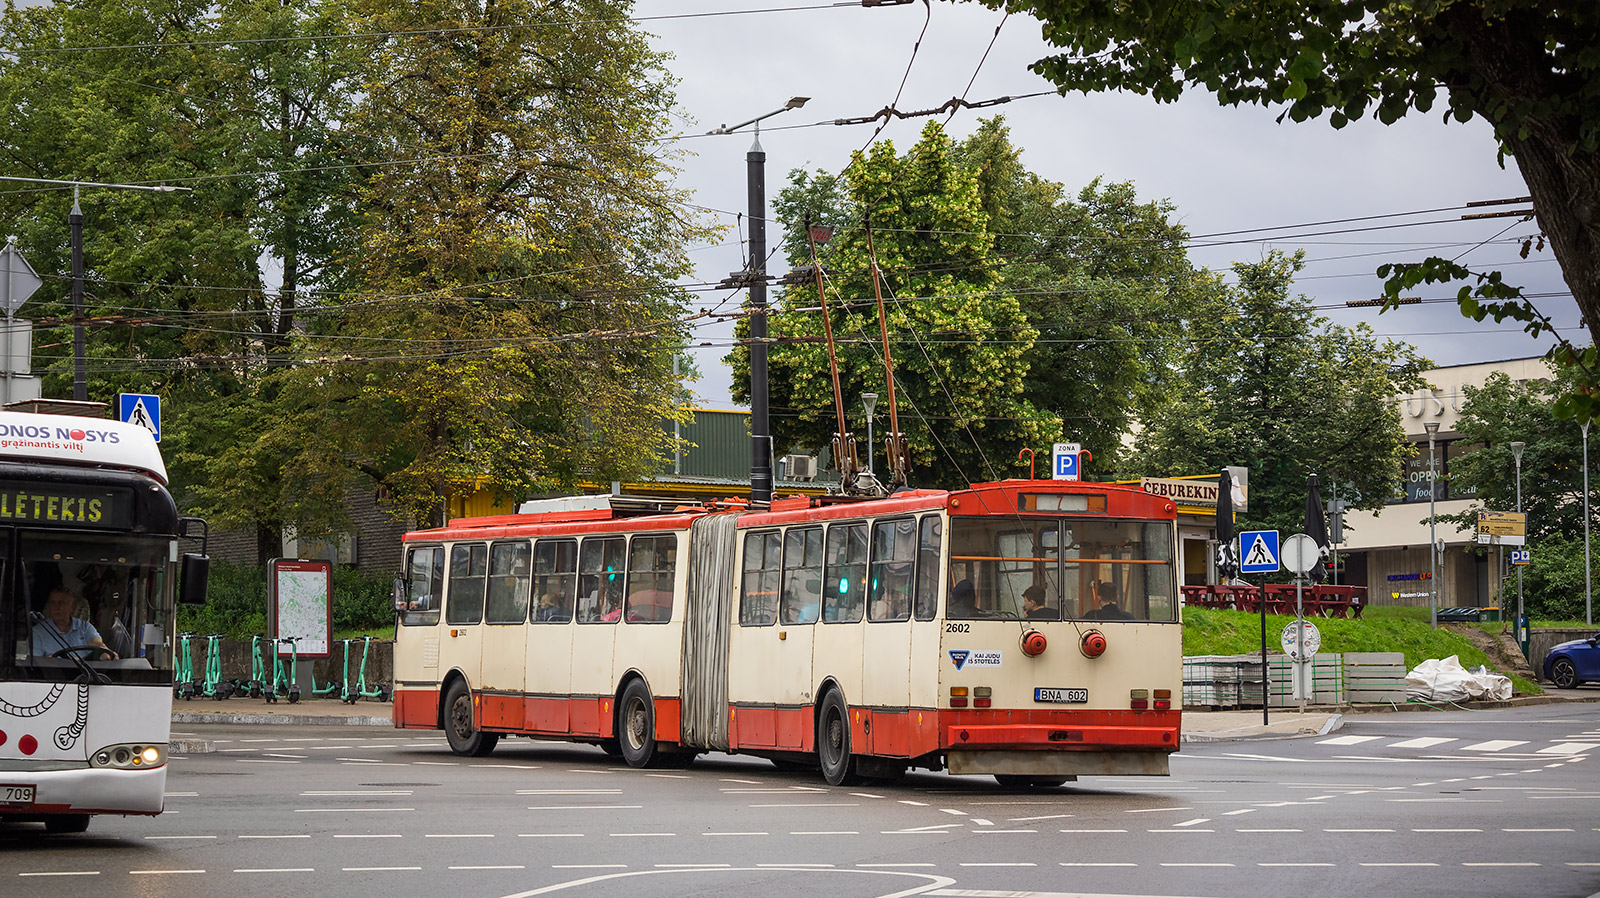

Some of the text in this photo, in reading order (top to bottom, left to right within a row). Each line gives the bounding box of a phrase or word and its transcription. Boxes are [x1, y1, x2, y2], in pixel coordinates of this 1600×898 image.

[1, 440, 84, 453] grąžinantis viltį
[1061, 456, 1073, 474] P
[1410, 469, 1440, 483] OPEN
[1143, 478, 1219, 500] ČEBUREKIN
[1056, 495, 1064, 511] 7
[1511, 551, 1520, 564] P
[945, 622, 970, 633] 2602
[1041, 690, 1086, 700] BNA 602
[6, 788, 31, 800] 709
